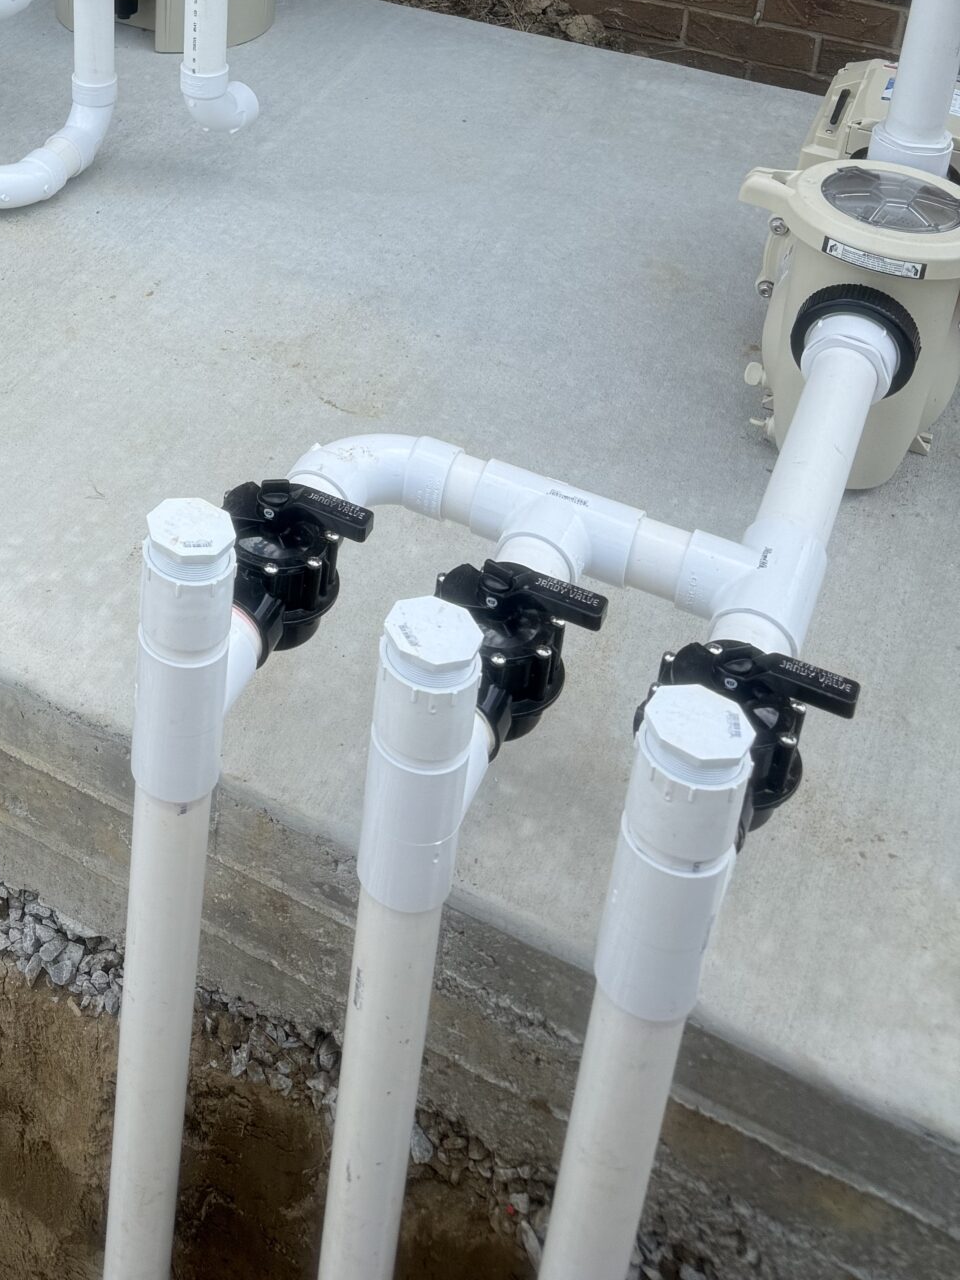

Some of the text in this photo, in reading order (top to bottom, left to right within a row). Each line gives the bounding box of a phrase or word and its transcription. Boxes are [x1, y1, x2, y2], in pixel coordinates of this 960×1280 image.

[307, 492, 366, 520] JANDY VALVE
[535, 578, 600, 607] JANDY VALVE
[779, 660, 853, 693] JANDY VALVE
